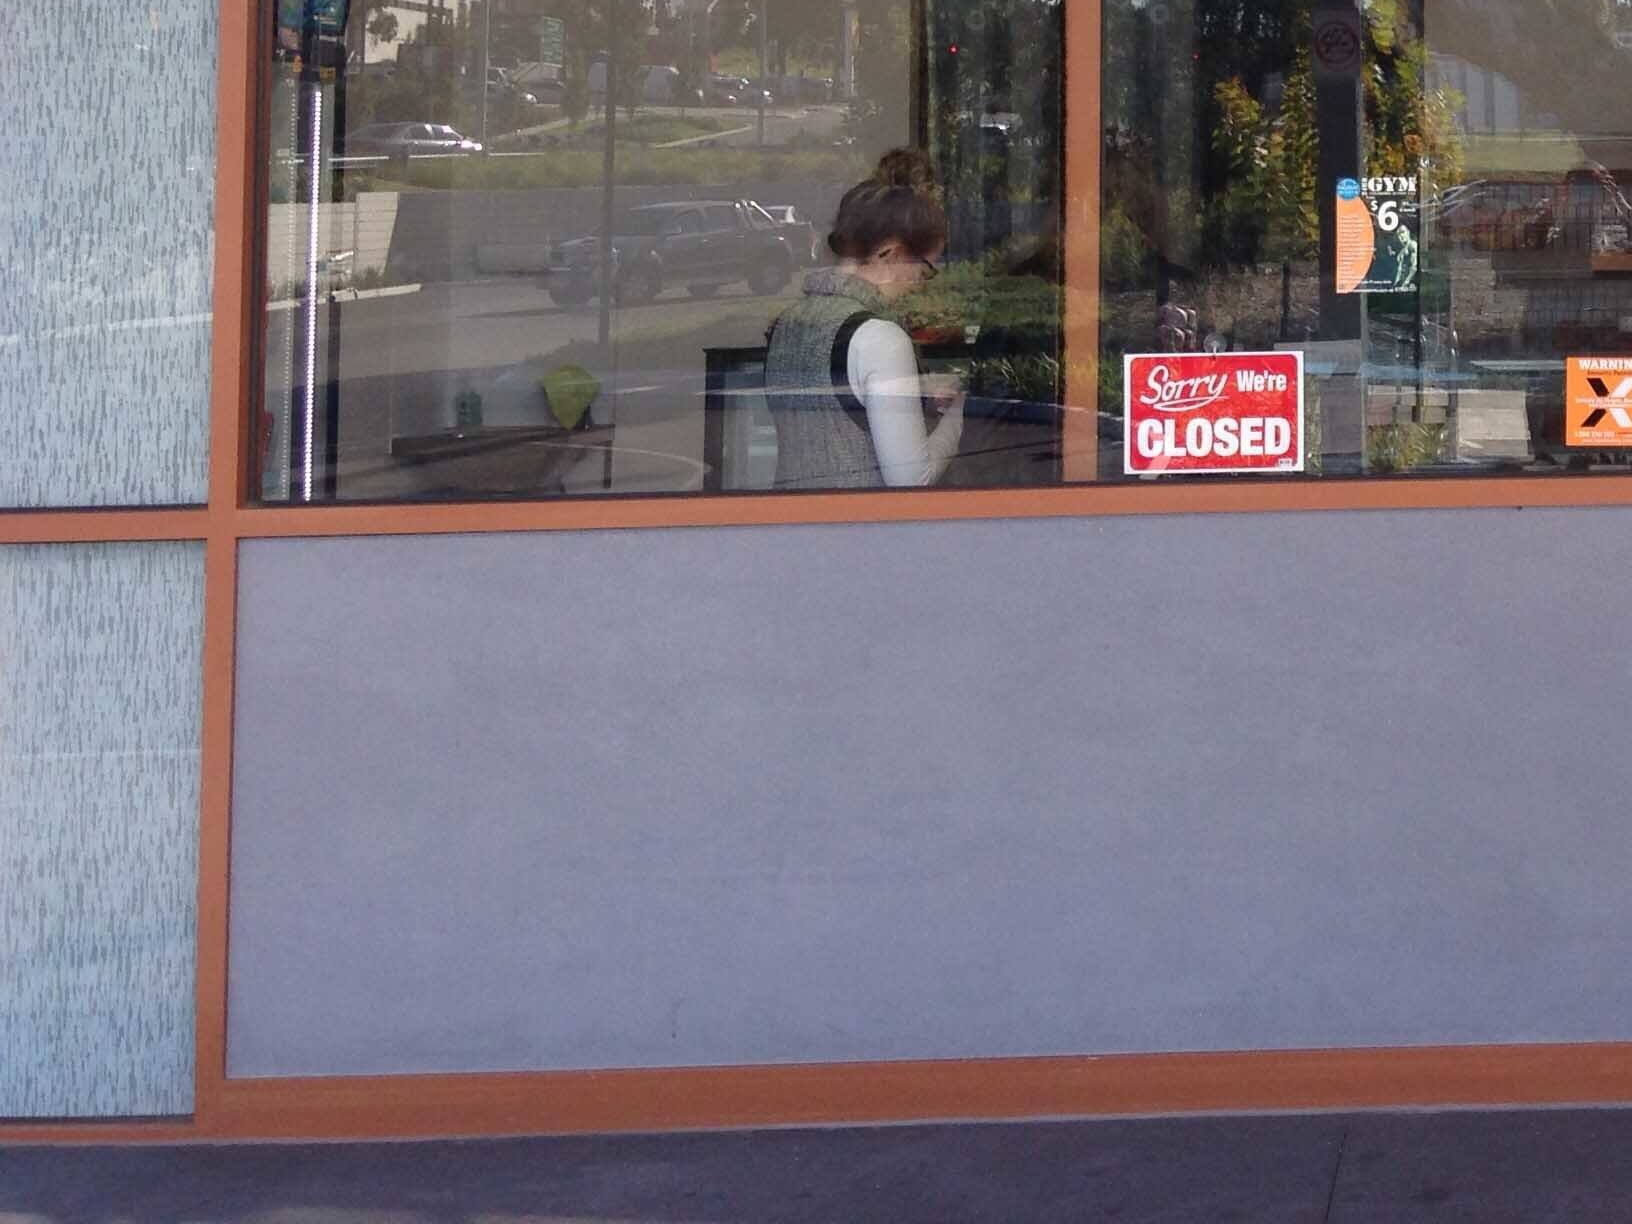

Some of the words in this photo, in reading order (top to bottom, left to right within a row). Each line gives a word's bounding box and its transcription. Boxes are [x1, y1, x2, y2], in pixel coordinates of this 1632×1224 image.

[1367, 176, 1417, 192] GYM
[1139, 364, 1231, 413] Sorry
[1236, 369, 1288, 393] We're
[1136, 416, 1292, 458] CLOSED
